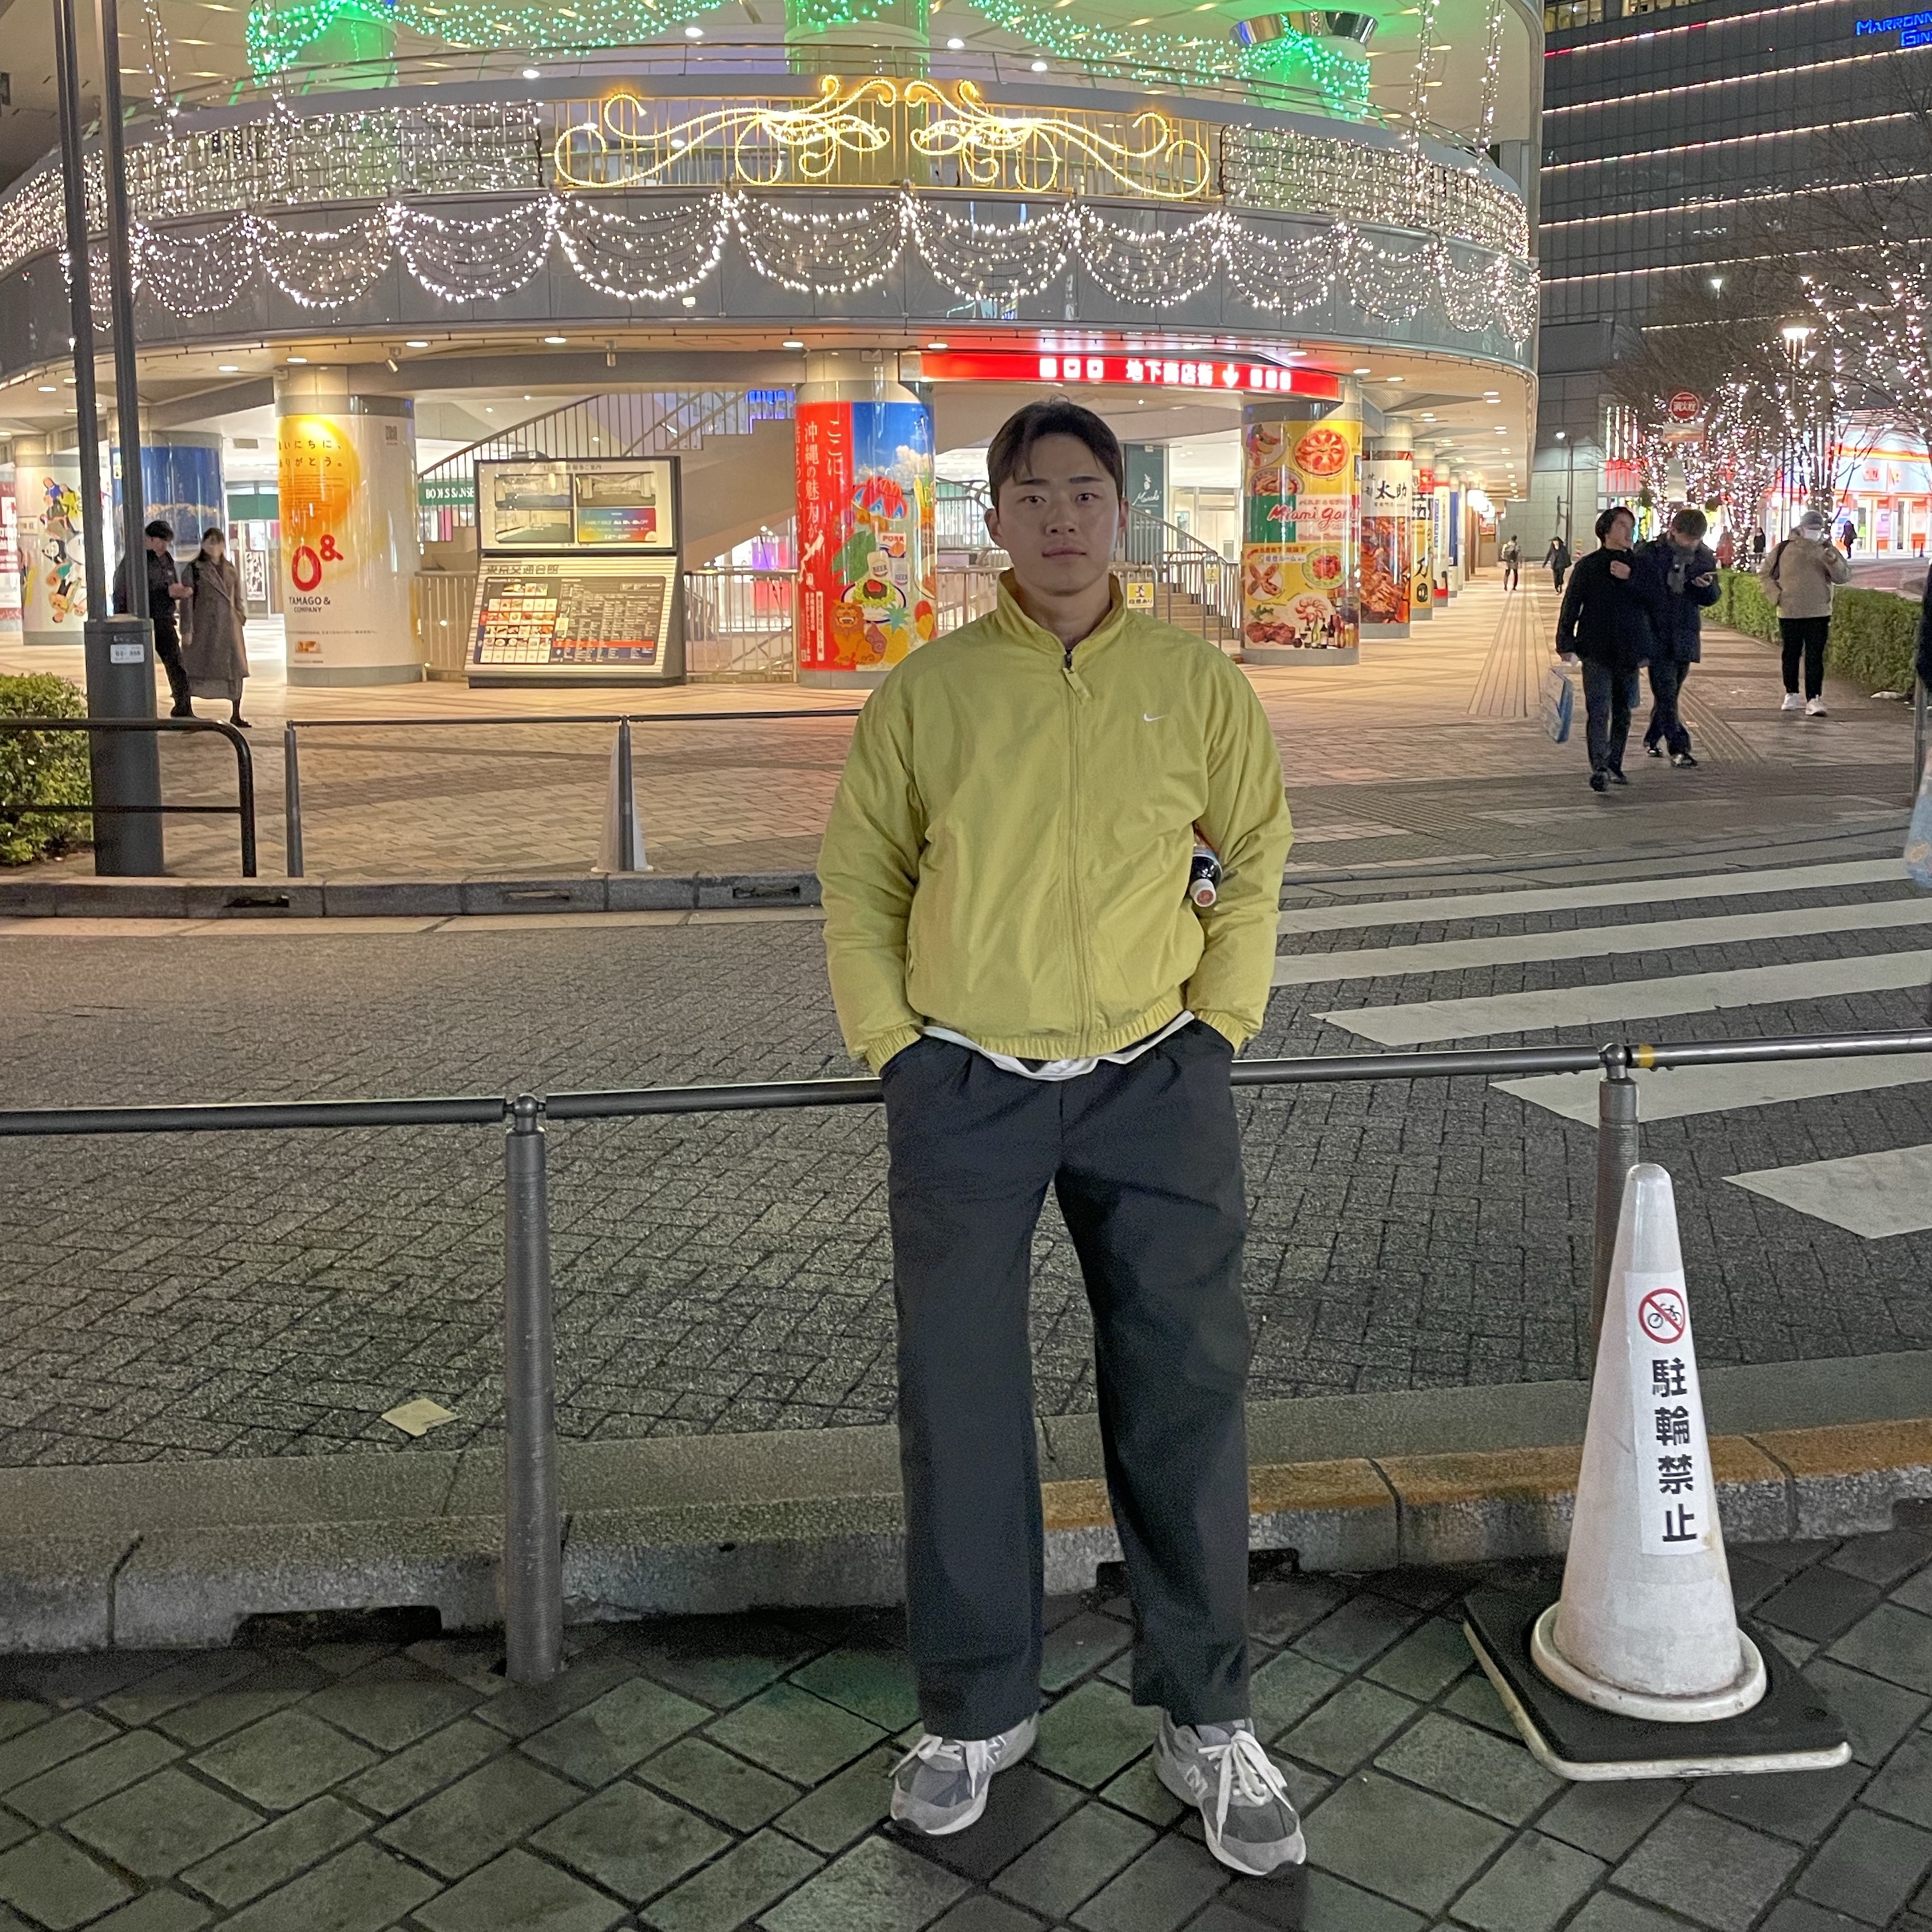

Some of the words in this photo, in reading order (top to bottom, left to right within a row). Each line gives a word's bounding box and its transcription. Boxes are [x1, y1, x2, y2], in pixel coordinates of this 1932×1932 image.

[1901, 29, 1932, 46] GIN
[827, 420, 843, 477] ここに
[804, 420, 820, 538] 沖縄の魅力が
[289, 596, 322, 606] TAMAGO
[324, 596, 331, 605] &
[1652, 1357, 1697, 1543] 駐輪禁止
